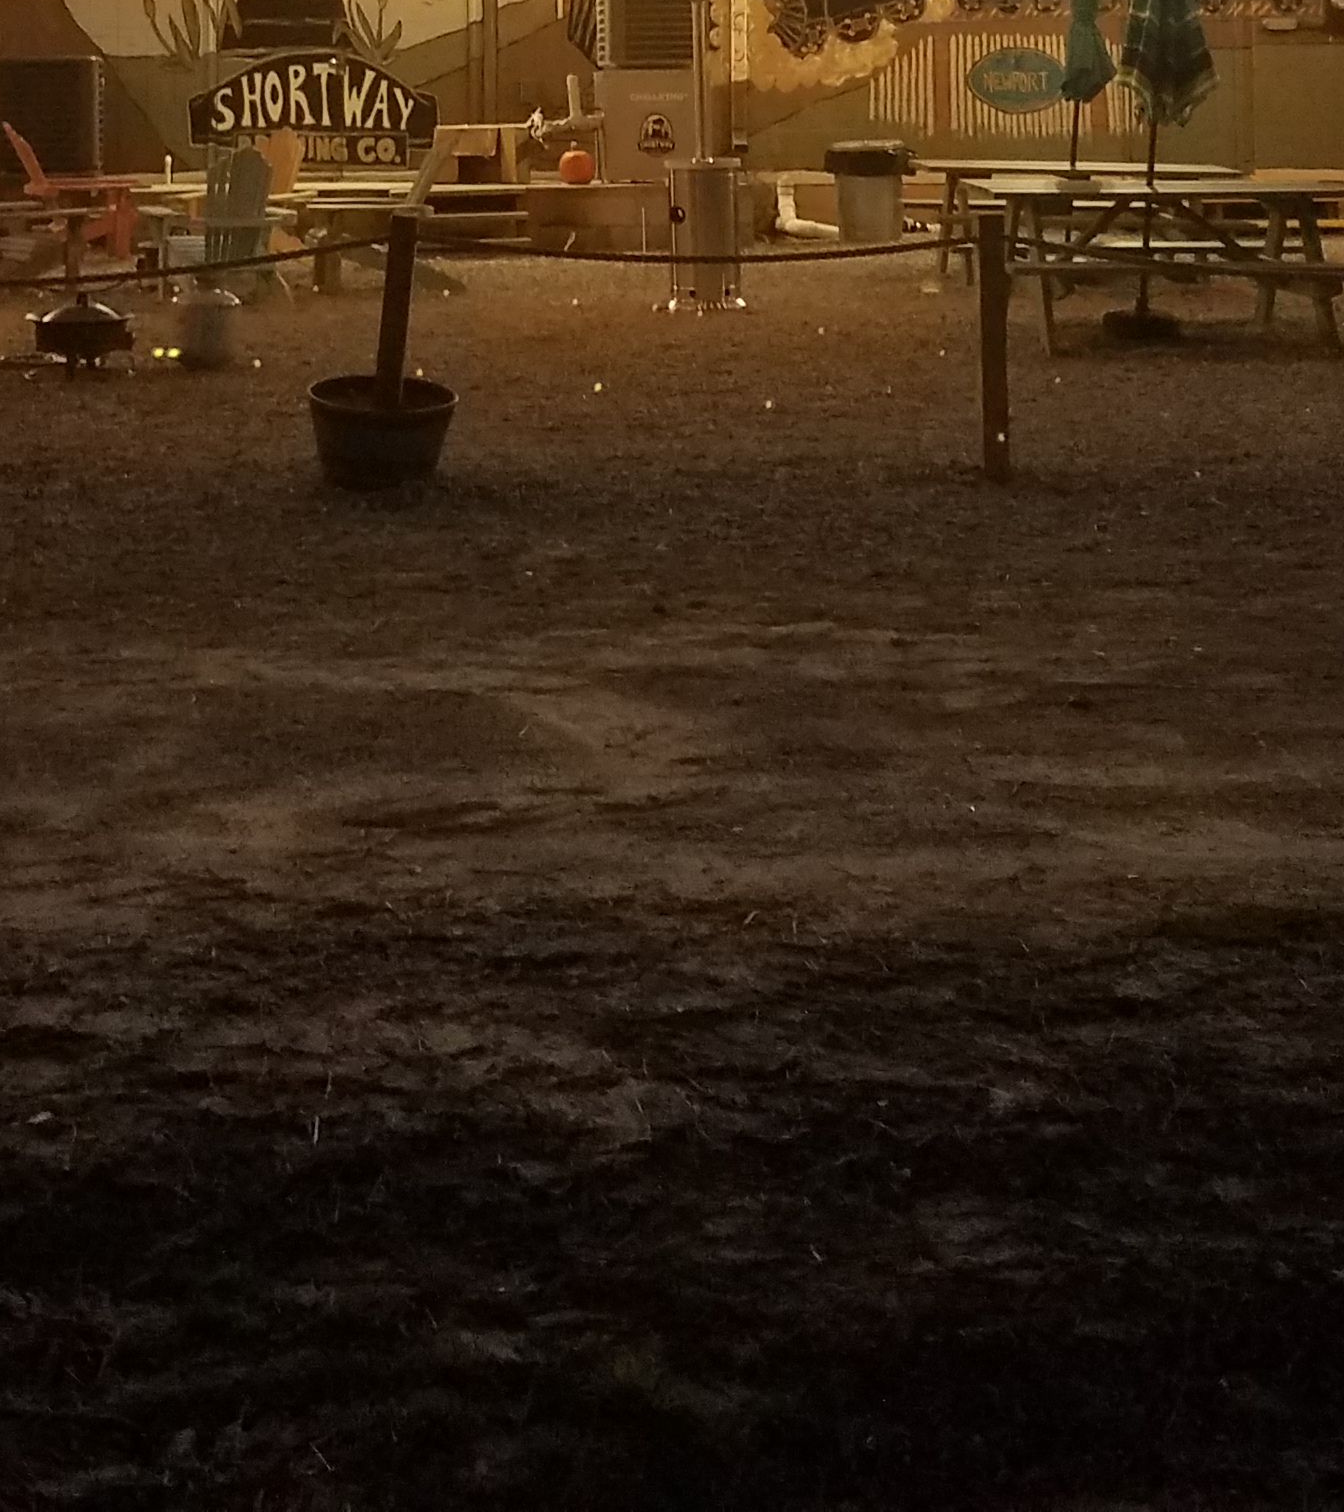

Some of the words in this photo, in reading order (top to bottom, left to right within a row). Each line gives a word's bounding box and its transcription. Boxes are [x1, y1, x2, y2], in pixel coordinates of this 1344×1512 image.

[983, 70, 1049, 93] NEWPORT
[211, 62, 415, 132] SHORTWAY
[356, 137, 401, 164] CO.
